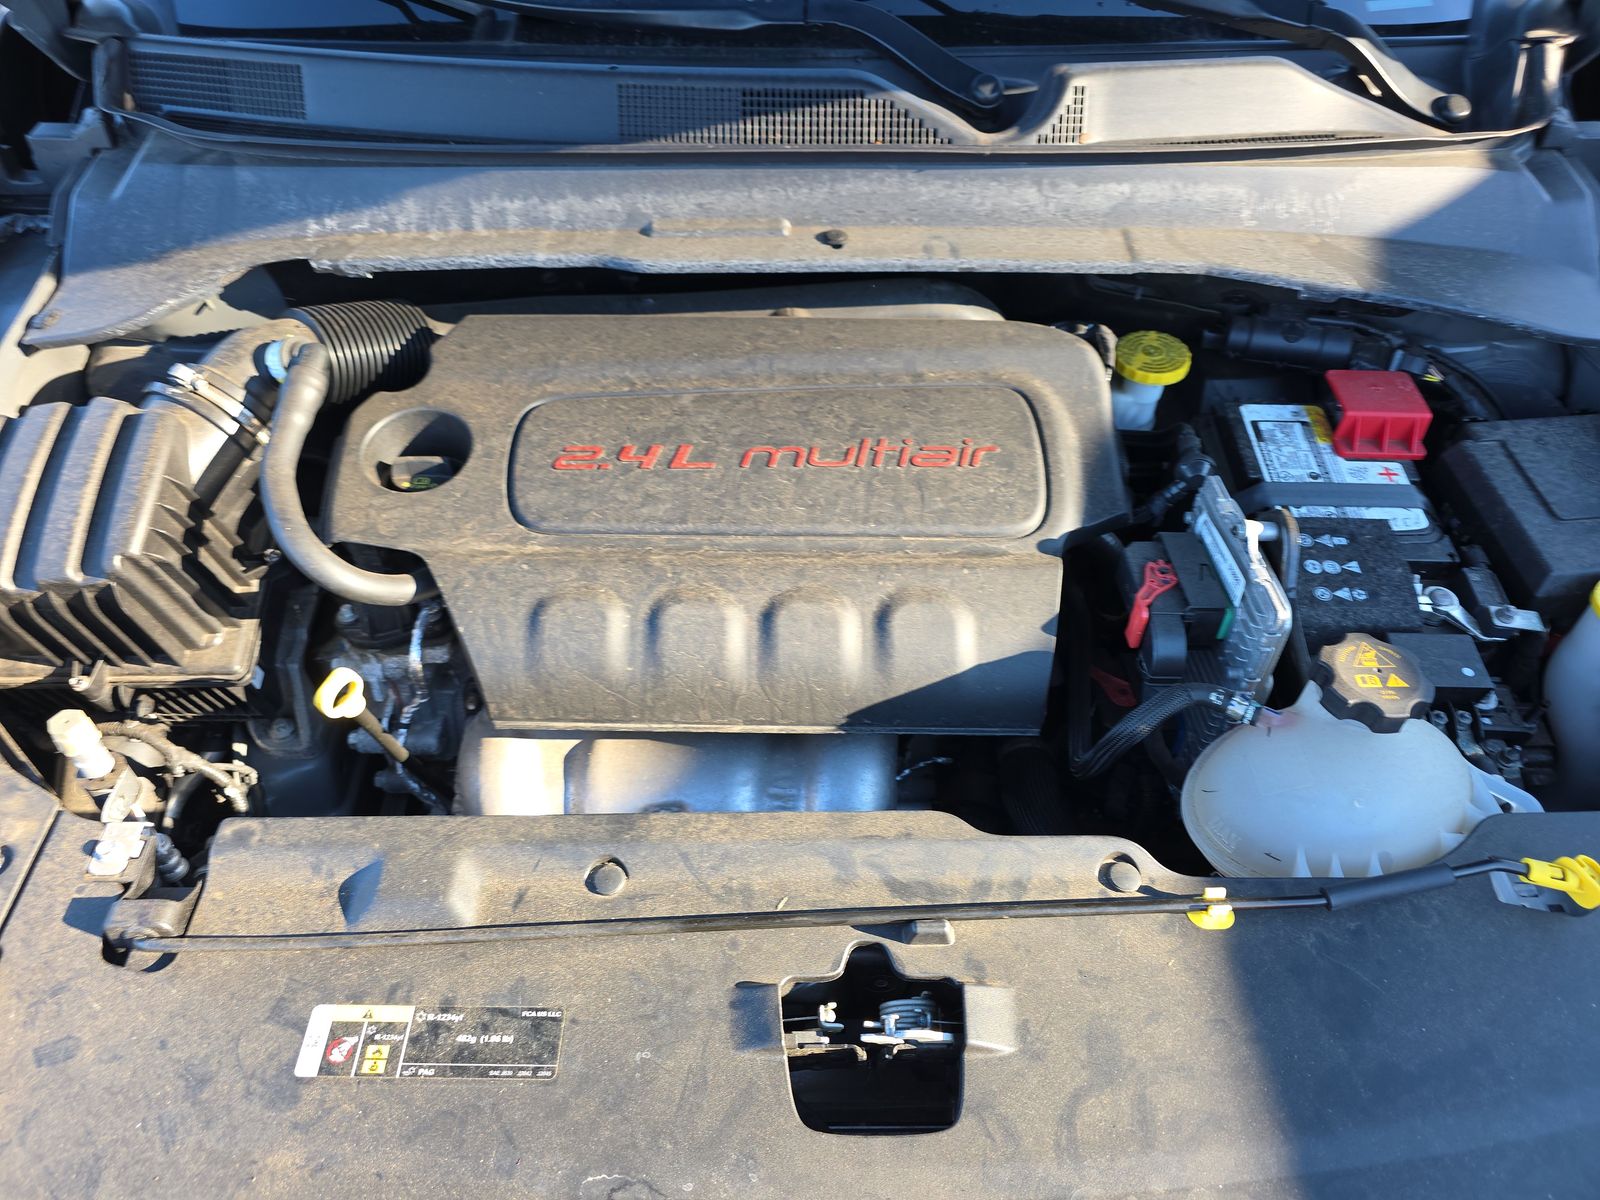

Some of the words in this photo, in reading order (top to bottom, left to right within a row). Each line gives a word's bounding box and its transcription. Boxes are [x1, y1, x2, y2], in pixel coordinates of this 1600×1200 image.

[739, 438, 1001, 469] multiair
[521, 1010, 536, 1018] FCA
[536, 1010, 548, 1018] US
[548, 1010, 562, 1018] LLC
[417, 1068, 435, 1076] PAG
